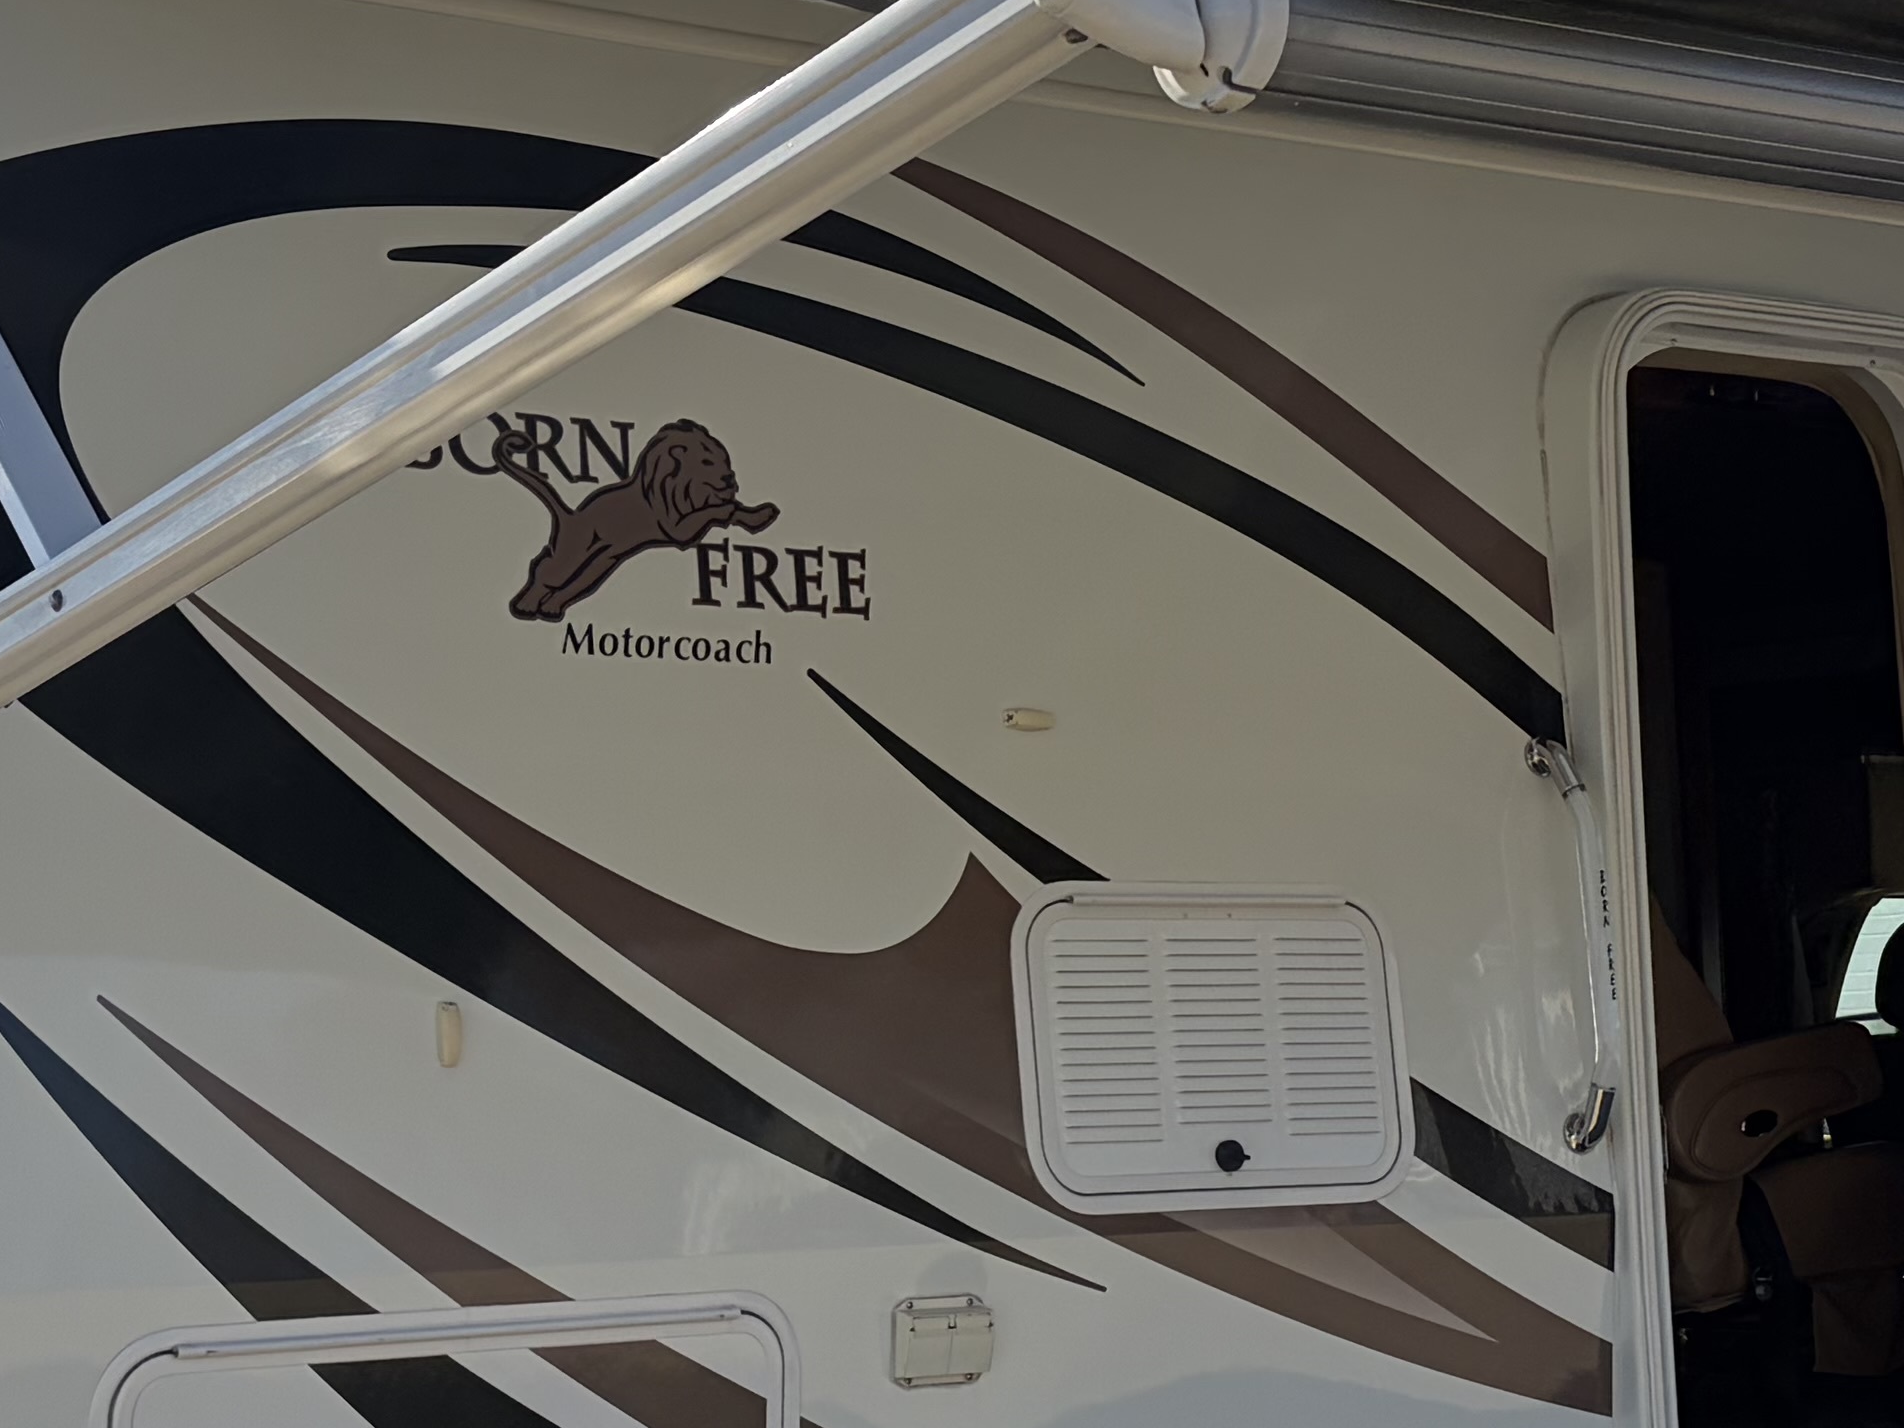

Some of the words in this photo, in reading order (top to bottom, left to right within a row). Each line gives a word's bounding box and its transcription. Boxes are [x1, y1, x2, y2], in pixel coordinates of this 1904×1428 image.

[405, 411, 635, 483] ORN
[692, 538, 871, 620] FREE
[562, 622, 773, 665] Motorcoach
